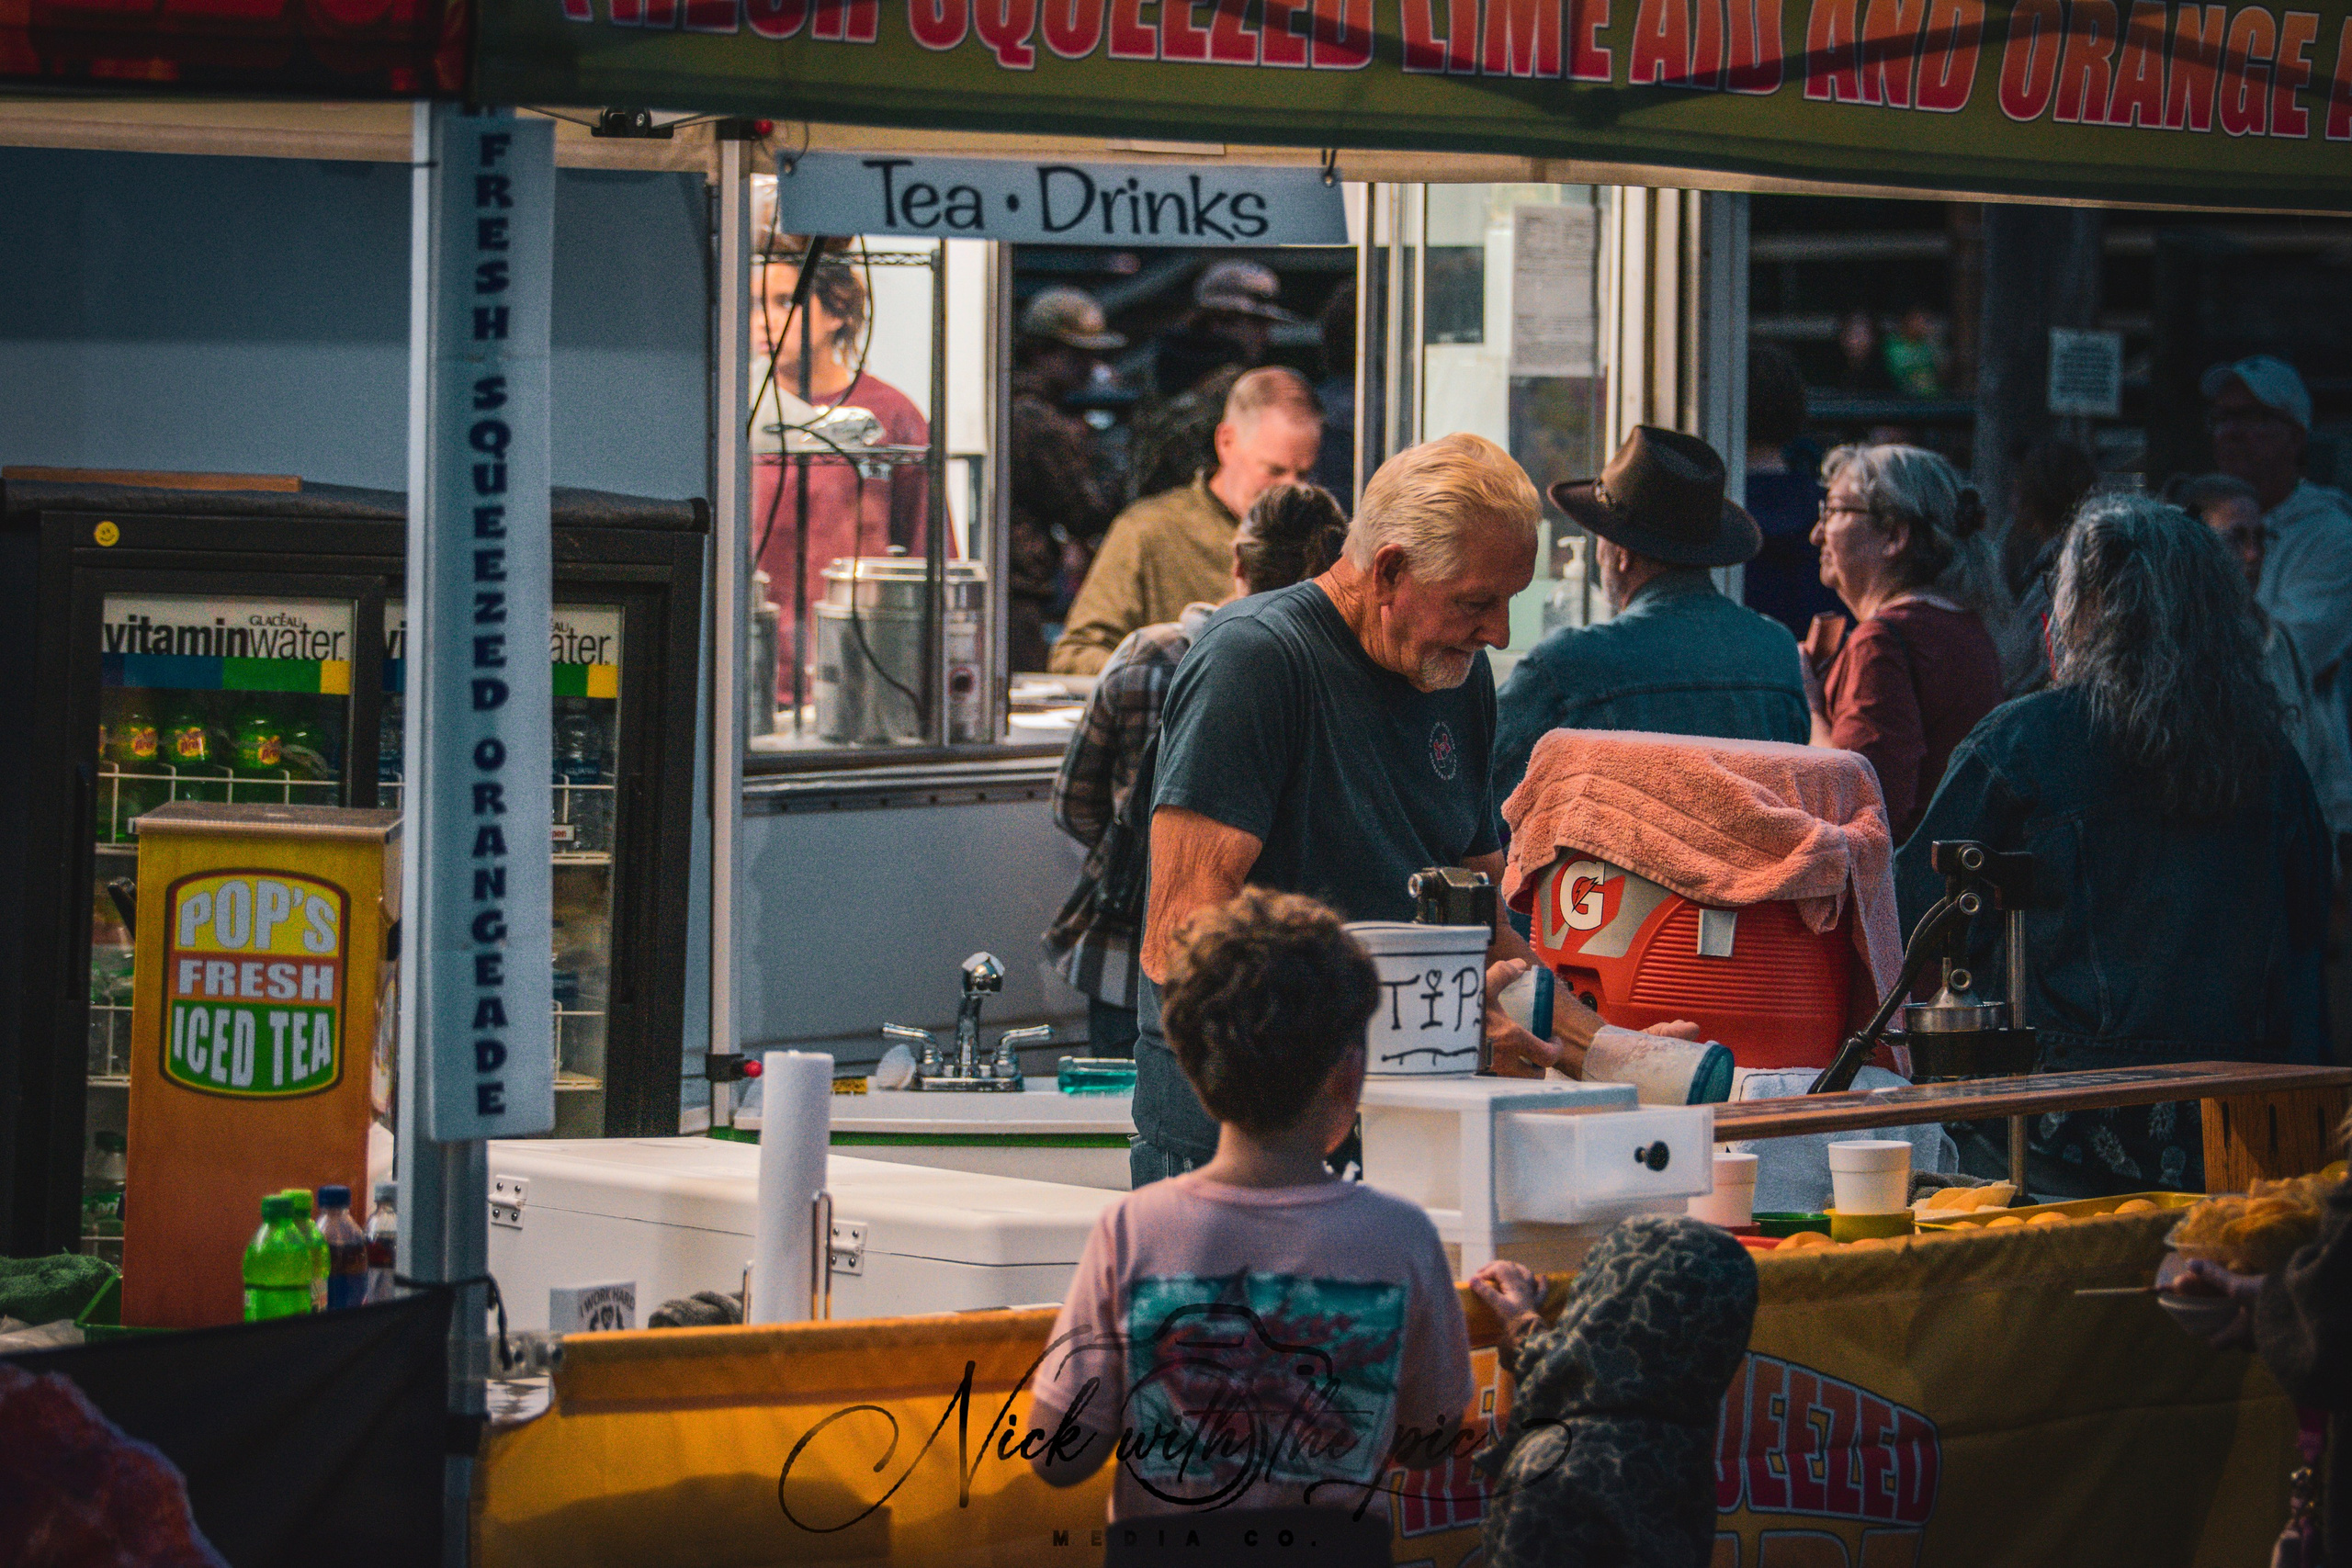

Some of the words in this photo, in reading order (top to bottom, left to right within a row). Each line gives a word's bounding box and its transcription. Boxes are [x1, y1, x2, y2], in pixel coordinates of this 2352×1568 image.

[1402, 0, 1612, 83] LIME
[1803, 0, 1984, 114] AND
[1997, 0, 2321, 139] ORANGE
[472, 132, 513, 341] FRESH
[863, 159, 984, 230] Tea
[1038, 165, 1270, 242] Drinks
[469, 374, 512, 714] SQUEEZED
[179, 878, 337, 953] POP'S
[471, 738, 509, 1117] ORANGEADE
[1559, 859, 1606, 931] G
[178, 960, 334, 1002] FRESH
[172, 1006, 255, 1087] ICED
[270, 1012, 333, 1086] TEA
[584, 1287, 611, 1311] WORK
[614, 1287, 635, 1311] HARD
